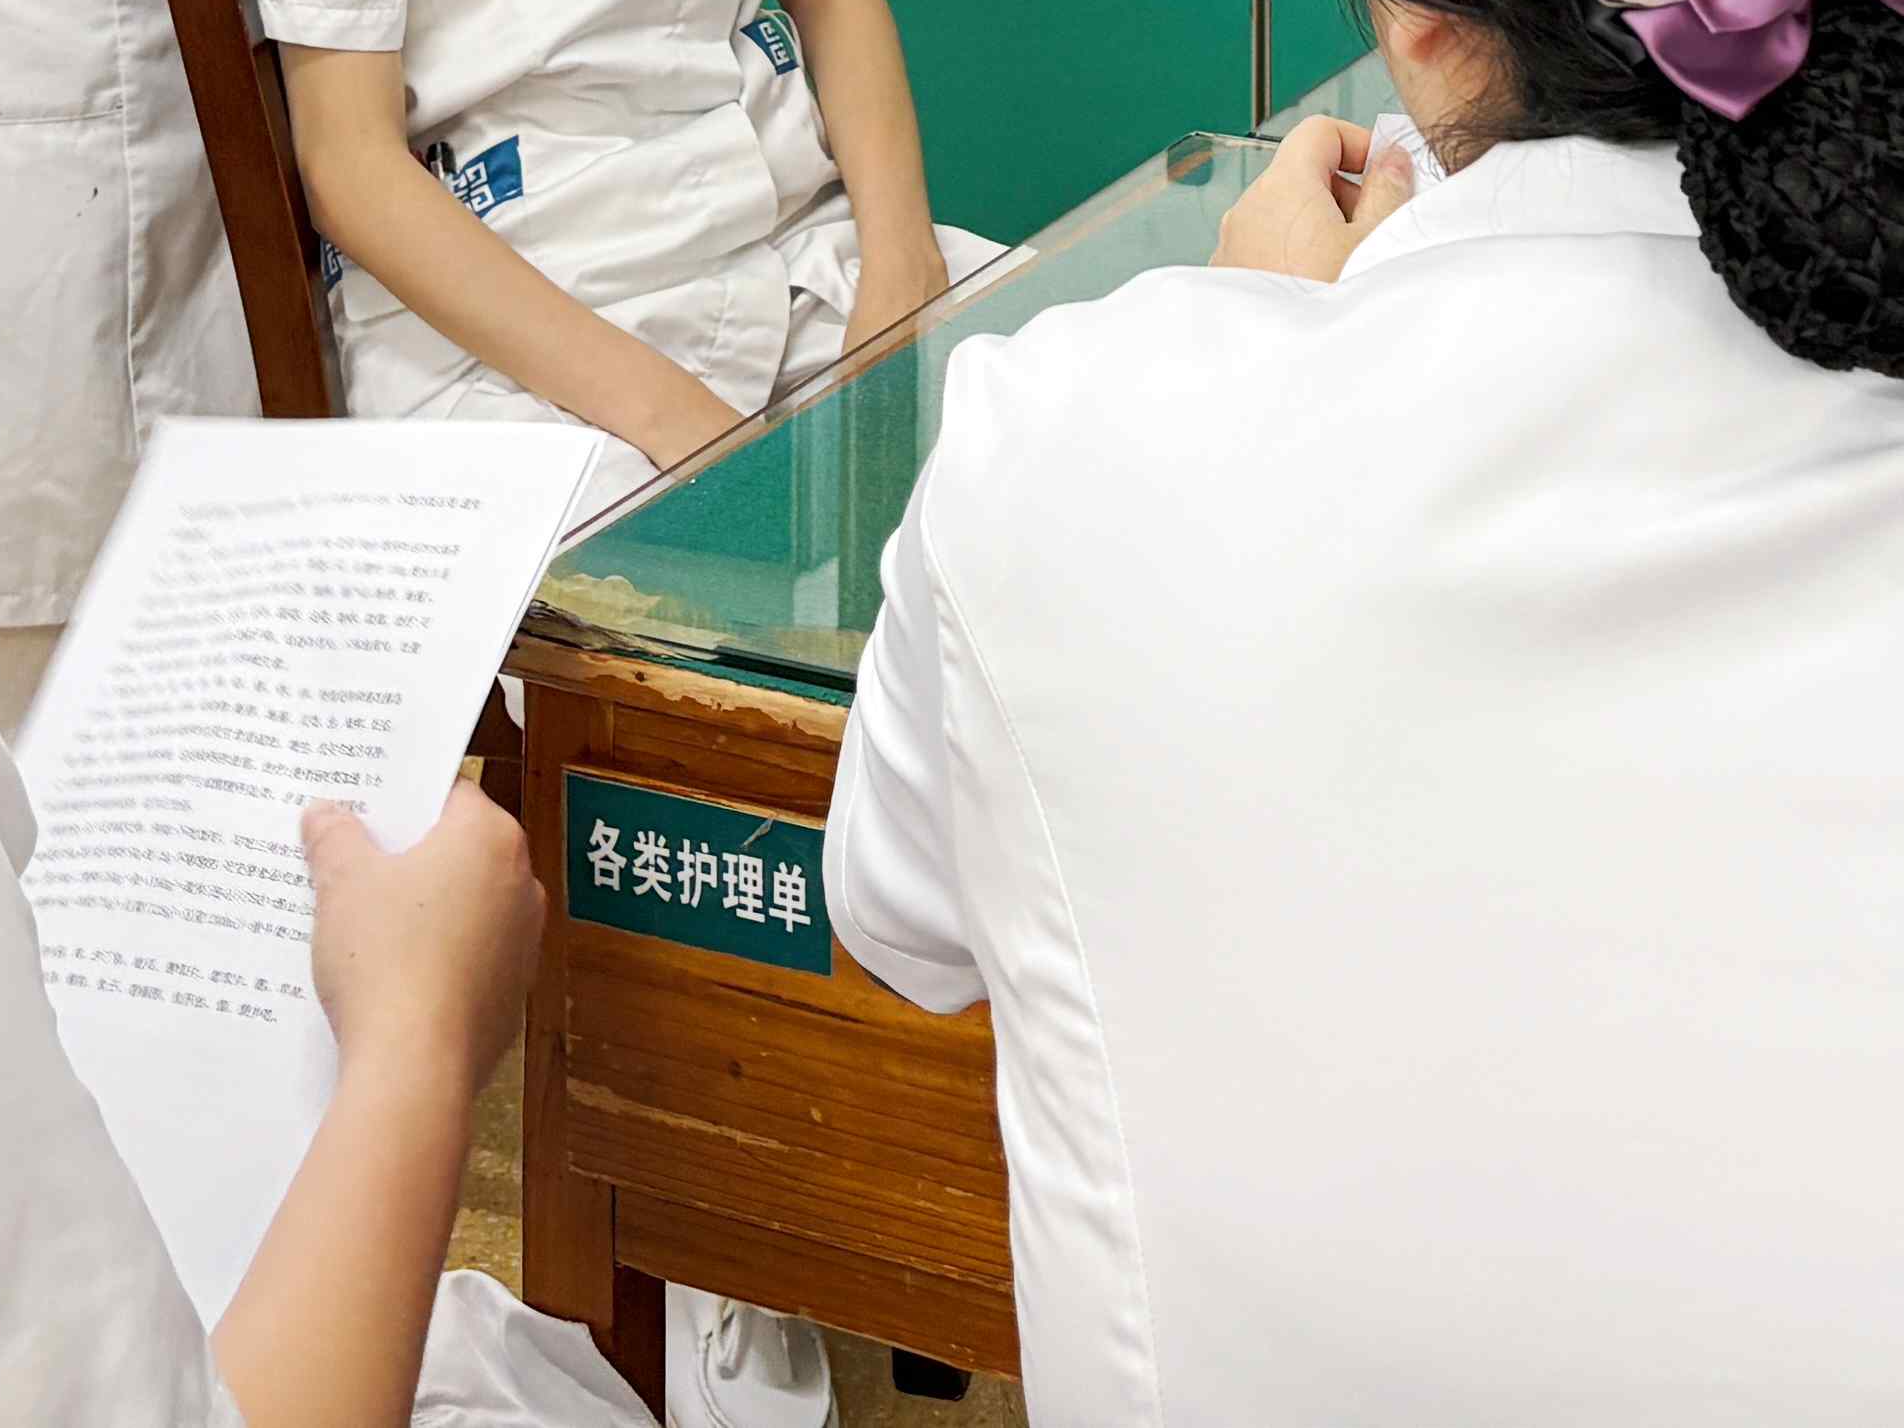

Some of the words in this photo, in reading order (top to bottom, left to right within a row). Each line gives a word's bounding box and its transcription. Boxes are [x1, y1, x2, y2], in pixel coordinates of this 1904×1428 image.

[586, 818, 812, 932] 各类护理单
